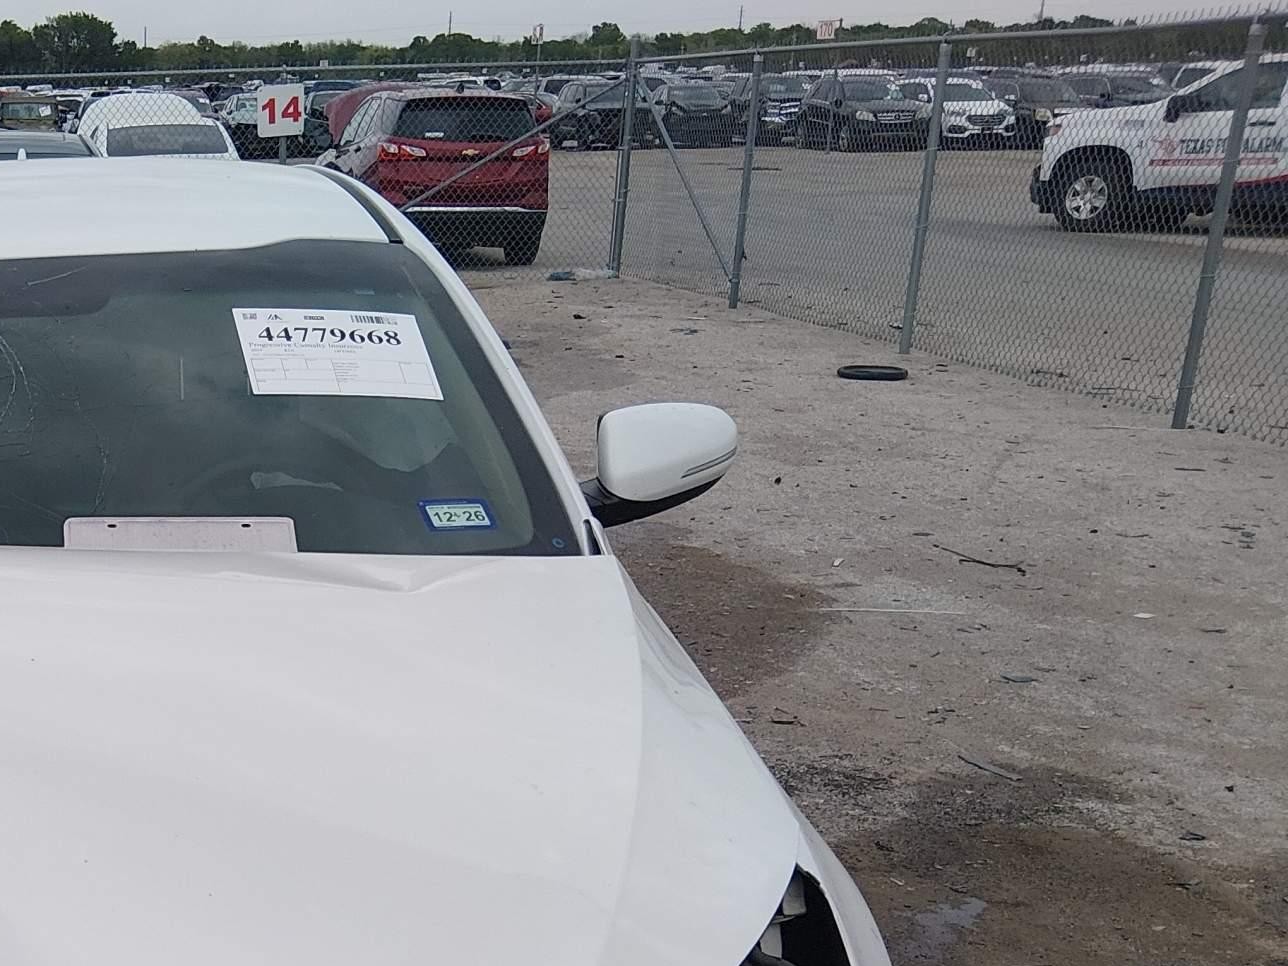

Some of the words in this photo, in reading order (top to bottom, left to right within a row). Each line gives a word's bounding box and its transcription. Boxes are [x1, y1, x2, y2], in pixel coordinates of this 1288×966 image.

[261, 96, 302, 124] 14
[1179, 138, 1213, 154] TEXAS
[1242, 137, 1285, 152] ALARM
[258, 326, 402, 346] 44779668
[462, 510, 486, 522] 26
